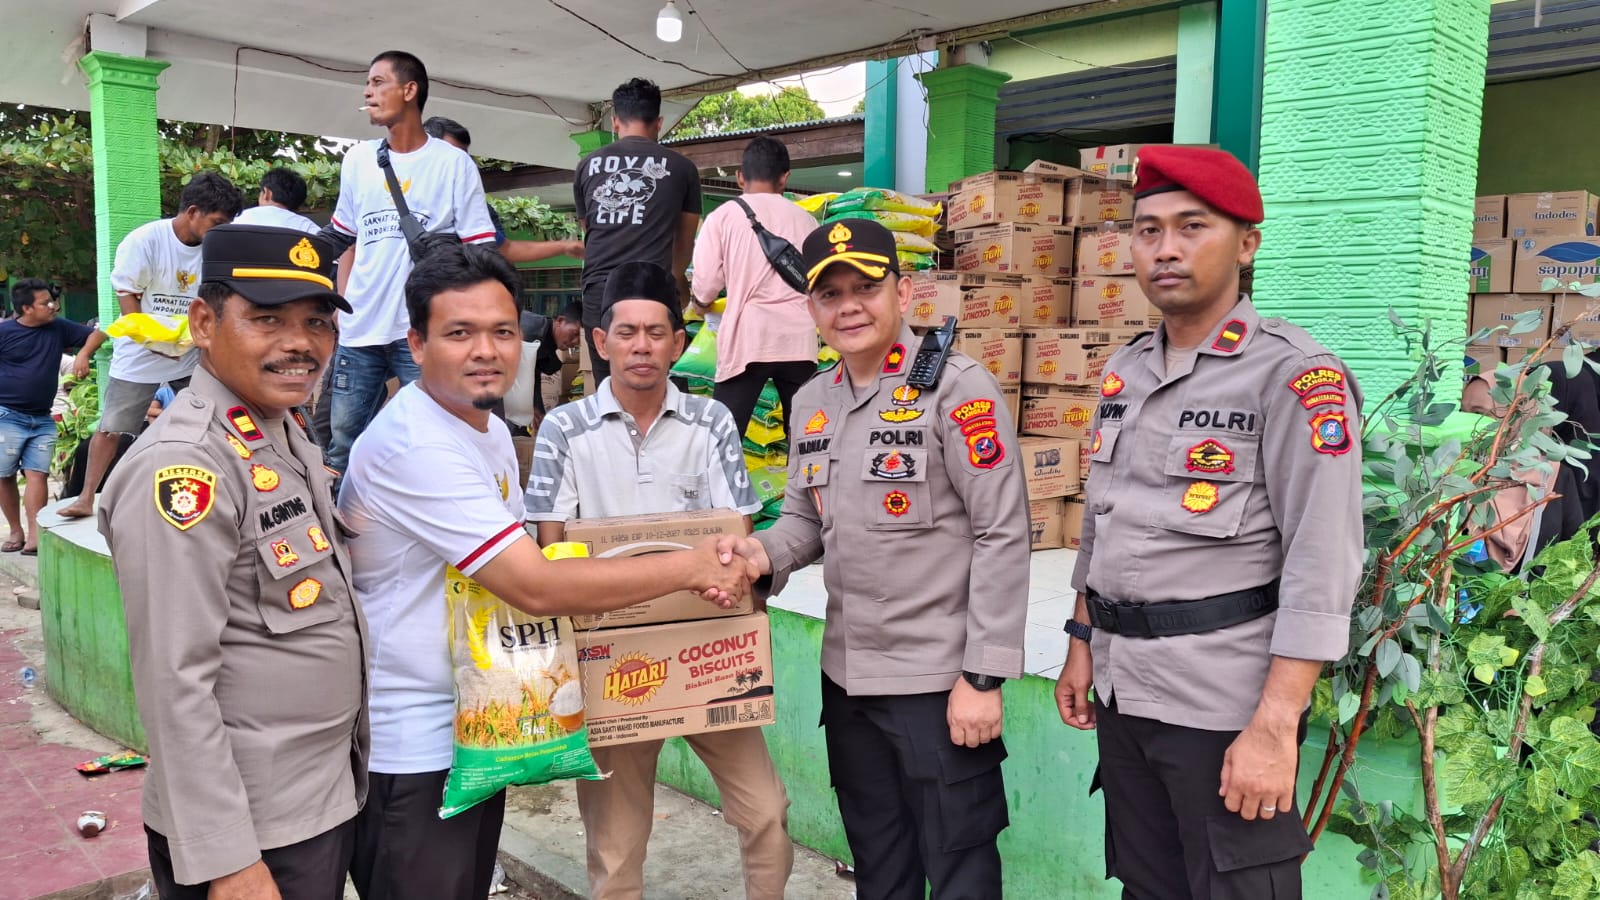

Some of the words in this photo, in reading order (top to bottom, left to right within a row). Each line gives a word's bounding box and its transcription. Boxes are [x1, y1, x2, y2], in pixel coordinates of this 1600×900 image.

[588, 156, 671, 176] ROYAL
[1018, 193, 1043, 201] COCONUT
[596, 203, 646, 225] LIFE
[1534, 210, 1577, 221] Indodes
[1538, 264, 1600, 278] ndodes
[912, 290, 938, 300] COCONUT
[965, 301, 988, 311] BISCUITS
[1098, 300, 1124, 310] COCONUT
[963, 309, 990, 321] COCONUT
[982, 349, 1005, 359] COCONUT
[1036, 349, 1060, 358] COCONUT
[1063, 407, 1090, 424] HATARI
[1179, 410, 1255, 432] POLRI
[1024, 420, 1058, 430] COCONUT
[869, 430, 923, 446] POLRI
[500, 617, 561, 648] SPH
[678, 630, 758, 664] COCONUT
[689, 651, 755, 678] BISCUITS
[603, 659, 668, 700] HATARI
[685, 678, 713, 690] Biskuit
[715, 673, 734, 682] Rasa
[521, 721, 532, 736] 5
[533, 725, 546, 736] kg
[633, 720, 650, 730] FOODS
[650, 717, 685, 728] MANUFACTURE
